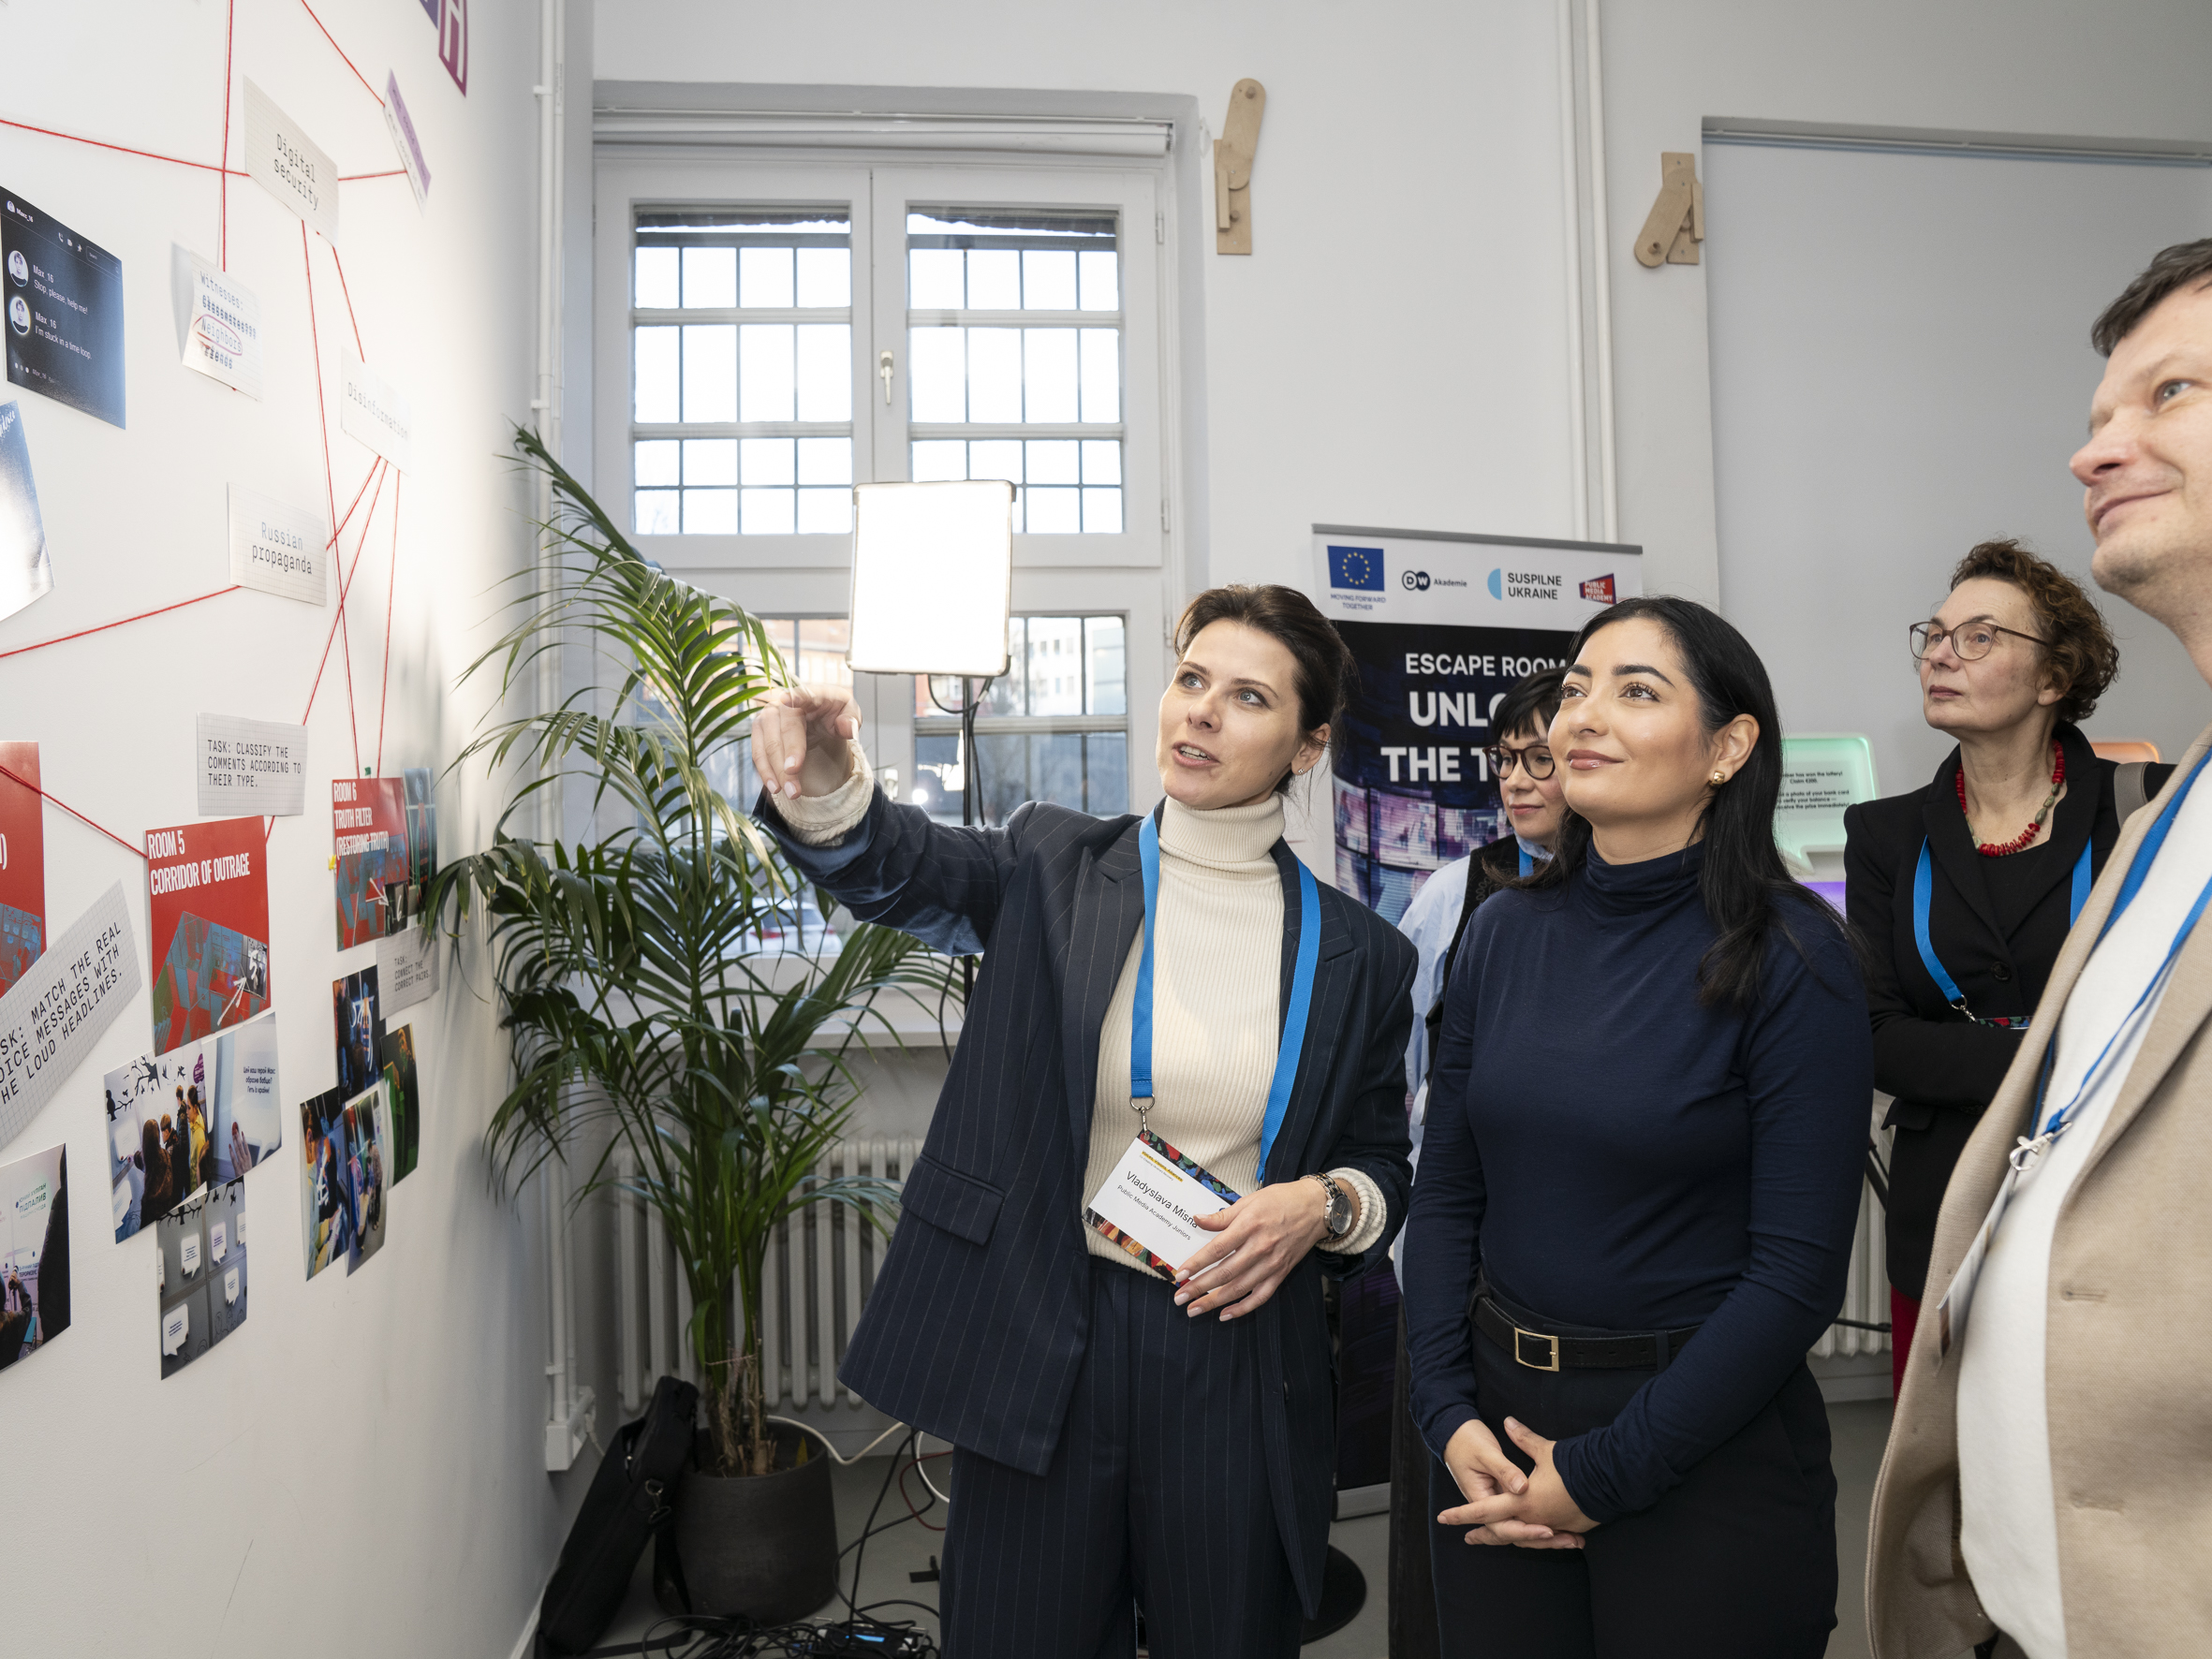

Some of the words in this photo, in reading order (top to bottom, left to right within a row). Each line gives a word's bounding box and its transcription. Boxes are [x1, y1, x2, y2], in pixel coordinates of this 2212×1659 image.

[277, 134, 316, 184] Digital
[33, 264, 54, 283] Max_16
[34, 280, 48, 295] Stop,
[49, 288, 67, 305] please,
[67, 298, 78, 311] help
[79, 303, 88, 315] me!
[200, 271, 243, 311] Witnesses:
[35, 311, 57, 330] Max_16
[201, 318, 242, 352] Neighbors
[36, 325, 44, 337] I'm
[45, 330, 58, 343] stuck
[59, 337, 65, 345] in
[69, 342, 80, 354] time
[81, 346, 92, 360] loop.
[348, 382, 407, 441] Disinformation
[262, 521, 303, 551] Russian
[253, 545, 312, 575] propaganda
[1434, 579, 1467, 588] Akademie
[1508, 572, 1562, 586] SUSPILNE
[1508, 587, 1558, 600] UKRAINE
[1405, 653, 1496, 676] ESCAPE
[1409, 691, 1506, 727] UNL
[208, 740, 230, 753] TASK:
[236, 742, 272, 756] CLASSIFY
[276, 746, 288, 758] THE
[208, 756, 245, 771] COMMENTS
[250, 760, 288, 773] ACCORDING
[293, 762, 302, 773] TO
[1380, 747, 1461, 782] THE
[208, 773, 232, 786] THEIR
[237, 774, 258, 787] TYPE.
[333, 782, 352, 802] ROOM
[352, 782, 357, 801] 6
[334, 808, 355, 830] TRUTH
[355, 807, 373, 828] FILTER
[147, 831, 177, 859] ROOM
[177, 830, 185, 855] 5
[336, 833, 370, 860] (RESTORING
[370, 830, 390, 852] TRUTH)
[150, 862, 200, 895] CORRIDOR
[200, 859, 212, 885] OF
[214, 852, 251, 882] OUTRAGE
[394, 956, 407, 966] TASK:
[395, 964, 413, 979] CONNECT
[415, 961, 423, 970] THE
[0, 1026, 23, 1060] SK:
[31, 977, 66, 1024] MATCH
[70, 951, 92, 979] THE
[96, 922, 122, 954] REAL
[395, 976, 414, 991] CORRECT
[0, 1041, 30, 1084] ICE
[36, 977, 90, 1045] MESSAGES
[94, 944, 120, 979] WITH
[0, 1078, 20, 1105] HE
[26, 1040, 56, 1079] LOUD
[61, 968, 123, 1040] HEADLINES.
[1127, 1170, 1172, 1210] Vladyslava
[1117, 1184, 1134, 1199] Public
[1133, 1197, 1149, 1210] Media
[1149, 1208, 1172, 1226] Academy
[1172, 1226, 1191, 1241] Juniors
